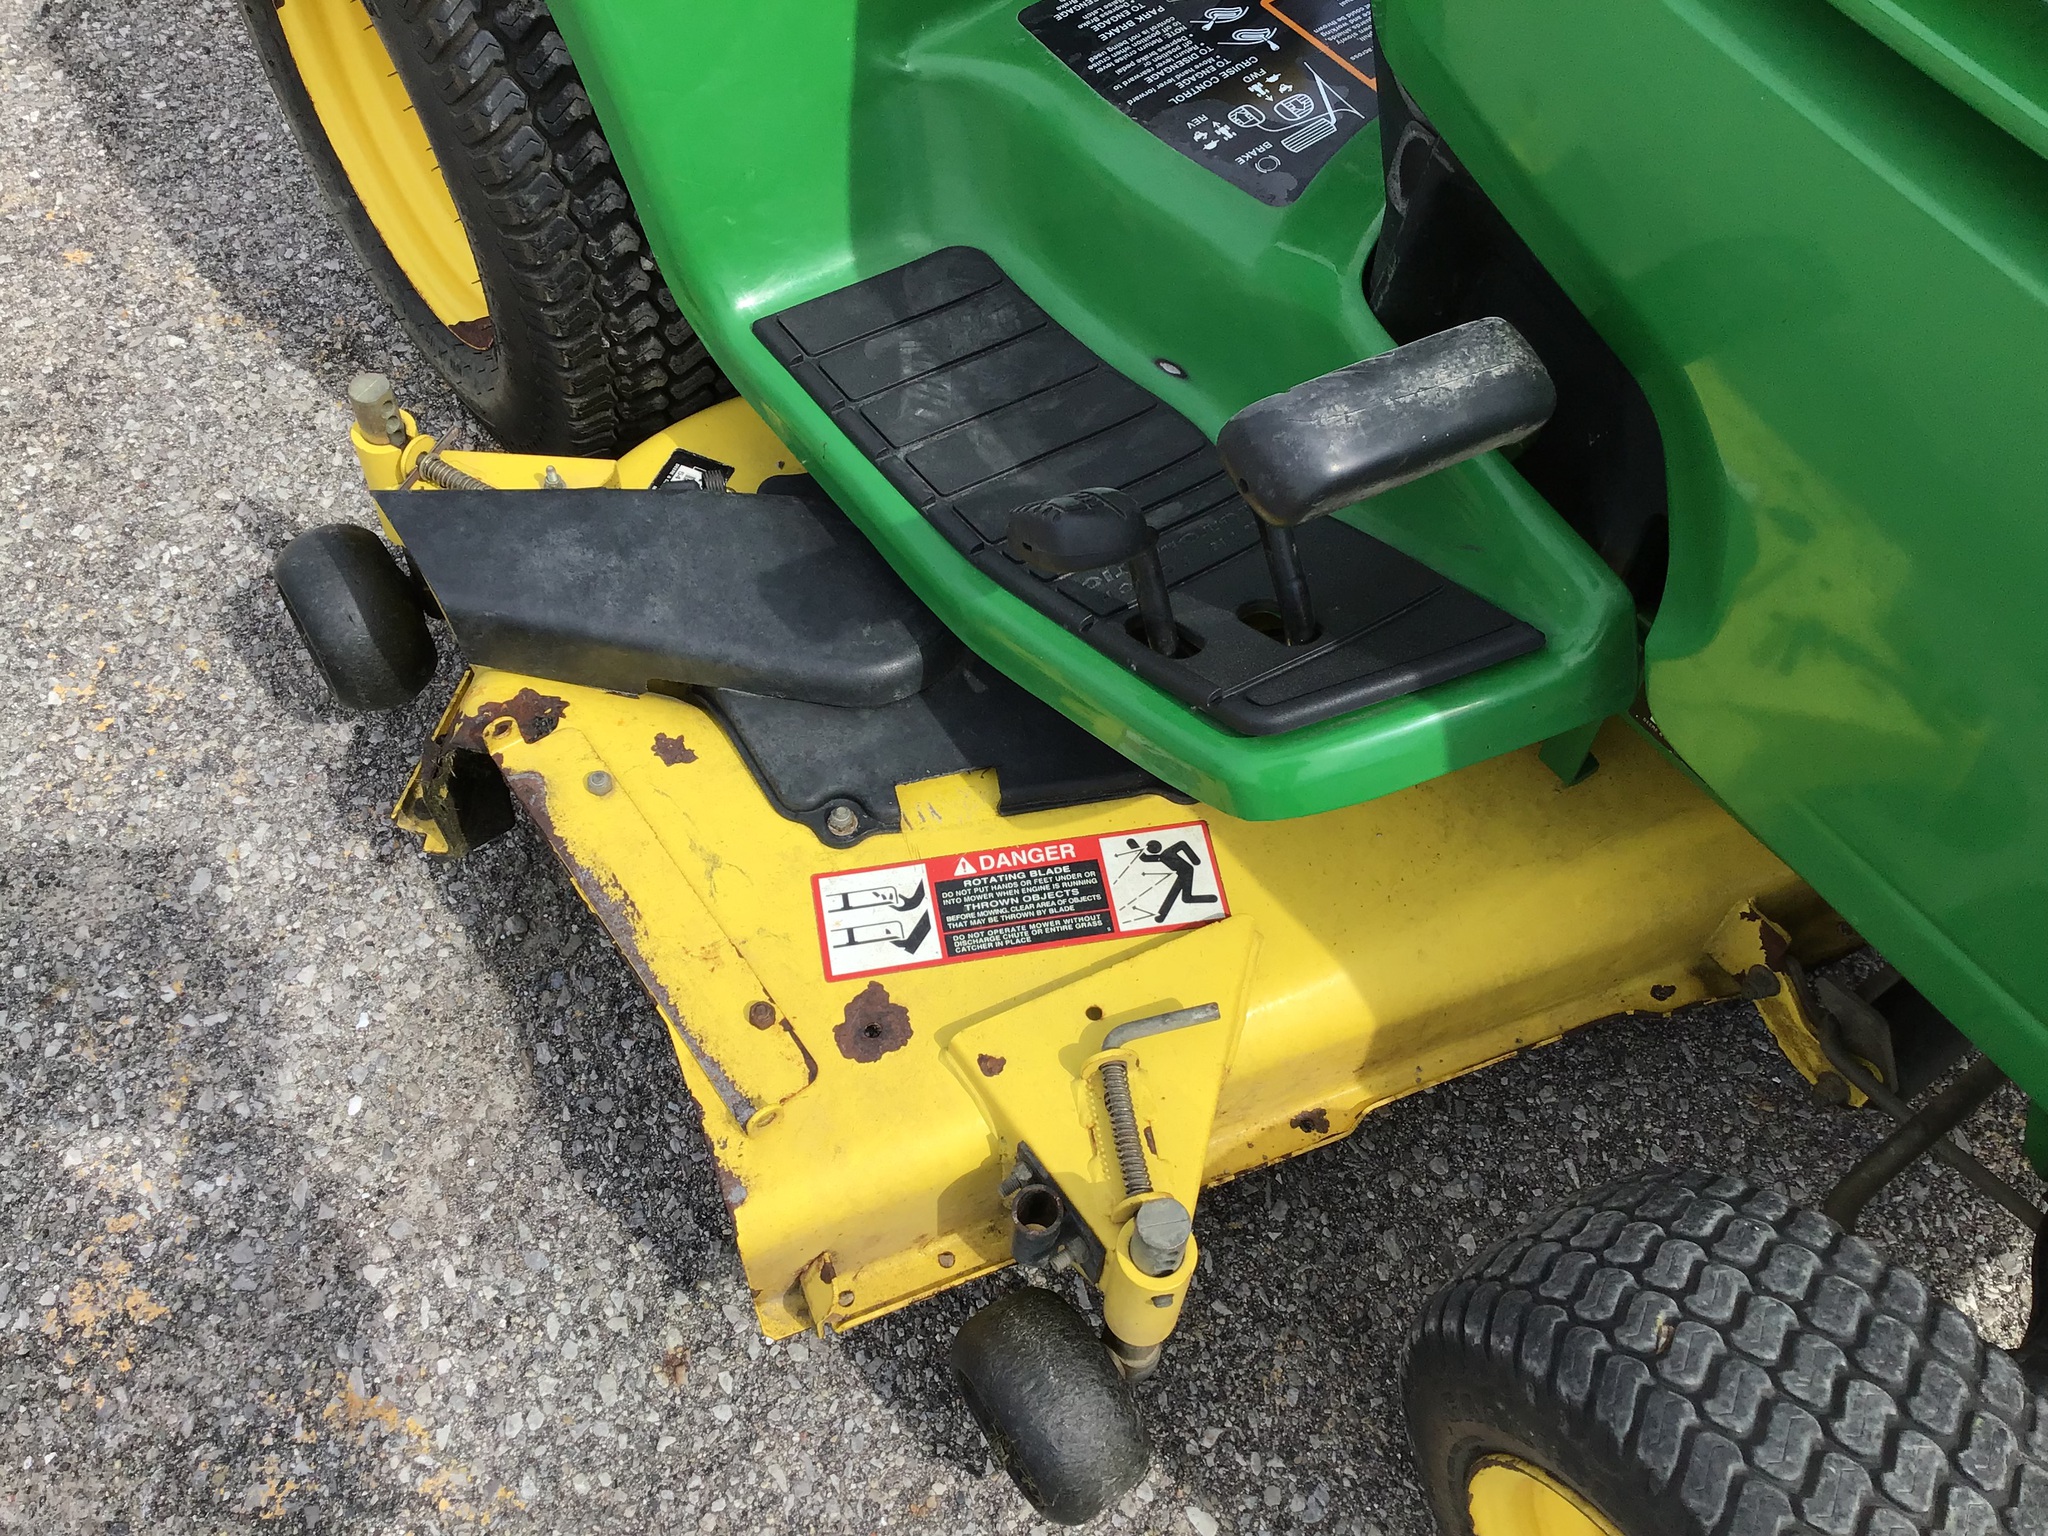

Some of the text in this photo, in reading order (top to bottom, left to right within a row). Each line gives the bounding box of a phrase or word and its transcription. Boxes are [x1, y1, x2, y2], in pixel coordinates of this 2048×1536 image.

[1077, 2, 1130, 29] Depress Brake
[1082, 8, 1104, 20] Latch
[1090, 2, 1146, 32] TO ENGAGE
[1336, 15, 1347, 23] be
[1345, 6, 1365, 18] could
[1097, 5, 1165, 41] PARK BRAKE
[1149, 16, 1176, 32] control
[1161, 25, 1173, 33] off
[1313, 20, 1338, 33] thrown
[1320, 15, 1362, 37] and working
[1106, 39, 1129, 53] being
[1128, 34, 1142, 42] not
[1131, 30, 1162, 48] position
[1336, 32, 1359, 45] slowly
[1087, 50, 1108, 62] used
[1095, 25, 1188, 74] NOTE: Return cruise lever
[1111, 45, 1132, 58] when
[1114, 34, 1188, 75] Depress brake pedal
[1149, 45, 1182, 64] position
[1173, 44, 1199, 59] Return
[1087, 56, 1112, 71] cruise
[1143, 45, 1214, 84] TO DISENGAGE
[1155, 57, 1174, 69] lever
[1121, 67, 1155, 86] rearward
[1126, 57, 1215, 105] Move hand lever forward
[1167, 56, 1258, 105] CRUISE CONTROL
[1175, 58, 1231, 89] TO ENGAGE
[1242, 68, 1267, 83] FWD
[1186, 114, 1208, 128] REV
[1234, 141, 1273, 165] BRAKE
[979, 843, 1076, 871] DANGER
[942, 891, 954, 899] DO
[955, 888, 972, 896] NOT
[974, 886, 989, 894] PUT
[991, 881, 1019, 891] HANDS
[1020, 879, 1032, 887] OR
[1033, 876, 1053, 885] FEET
[1055, 873, 1082, 882] UNDER
[963, 865, 1071, 887] ROTATING BLADE
[943, 897, 962, 906] INTO
[964, 892, 994, 902] MOWER
[996, 889, 1020, 897] WHEN
[1021, 884, 1051, 894] ENGINE
[1062, 878, 1098, 888] RUNNING
[964, 888, 1080, 912] THROWN OBJECTS
[946, 912, 976, 922] BEFORE
[1010, 903, 1035, 912] CLEAR
[1036, 900, 1056, 909] AREA
[1068, 894, 1101, 904] OBJECTS
[947, 921, 968, 929] THAT
[970, 918, 986, 926] MAY
[1000, 911, 1035, 921] THROWN
[1048, 905, 1075, 914] BLADE
[953, 914, 1101, 942] DO NOT OPERATE MOWER WITHOUT
[954, 935, 1001, 947] DISCHARGE
[1003, 931, 1029, 940] CHUTE
[1045, 924, 1073, 934] ENTIRE
[1075, 920, 1103, 930] GRASS
[955, 942, 994, 954] CATCHER
[1005, 936, 1032, 946] PLACE
